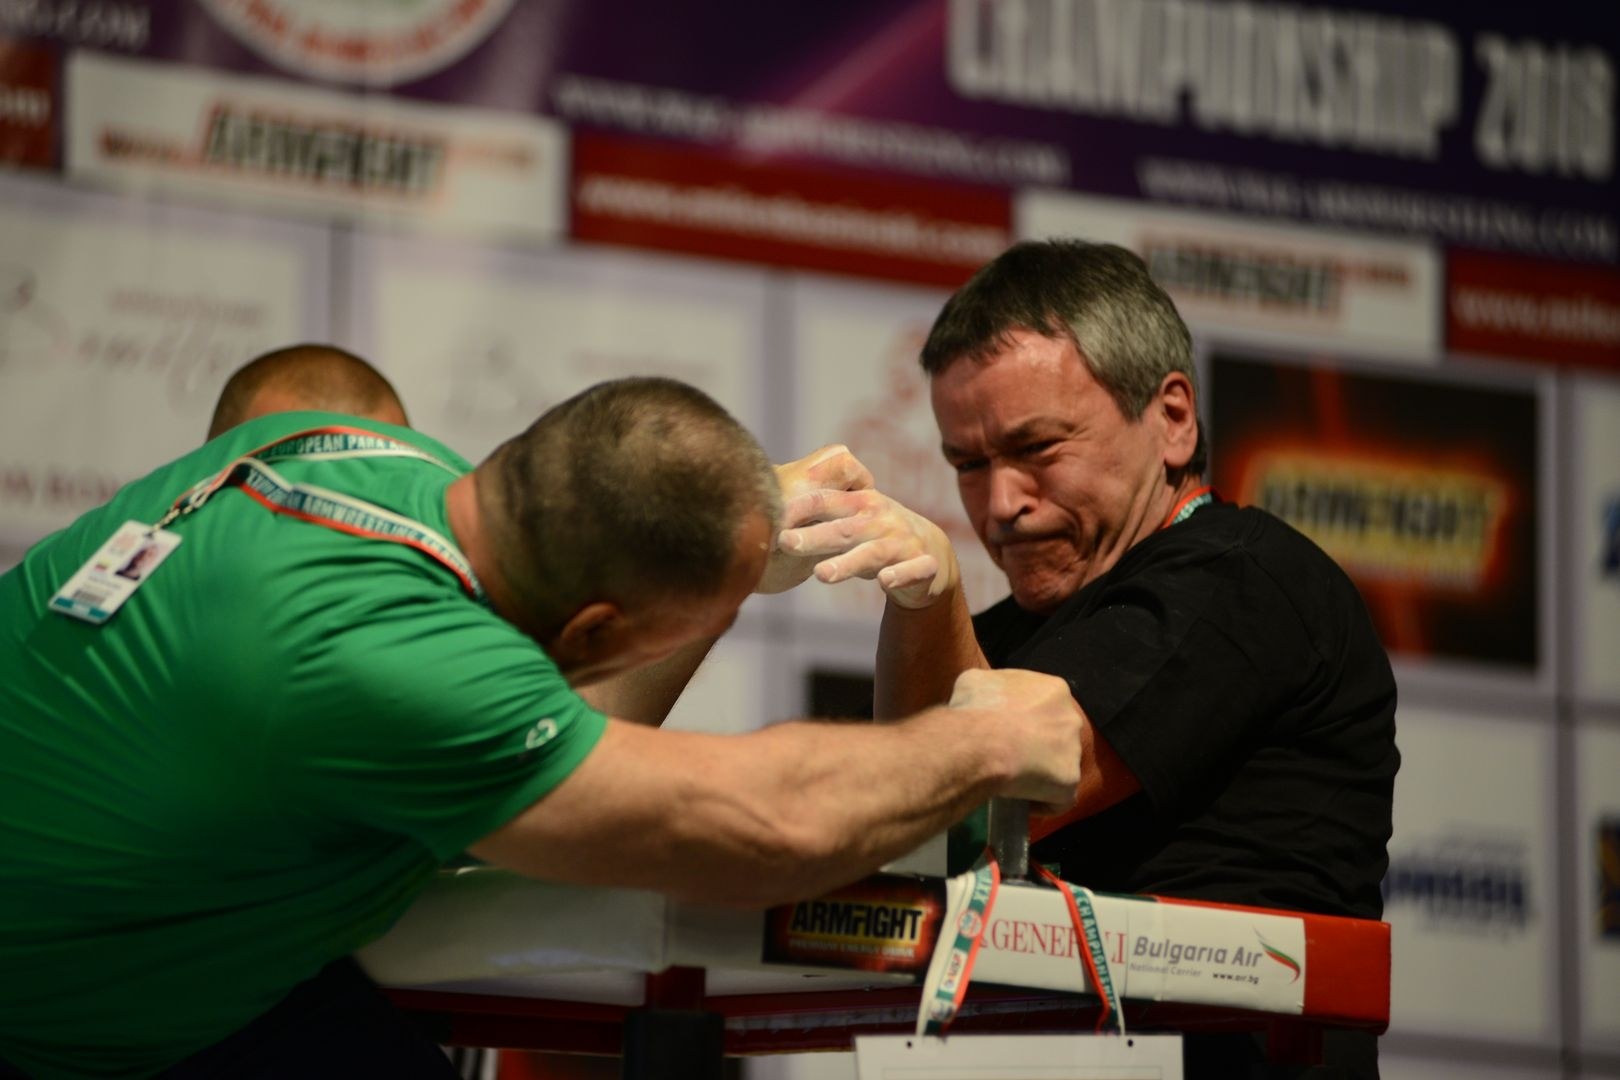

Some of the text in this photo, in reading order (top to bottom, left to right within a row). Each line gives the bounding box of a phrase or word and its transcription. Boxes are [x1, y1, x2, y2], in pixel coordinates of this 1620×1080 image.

[271, 434, 344, 458] EUROPEAN
[791, 901, 923, 941] ARMFIGHT
[1133, 936, 1263, 967] Bulgaria Air
